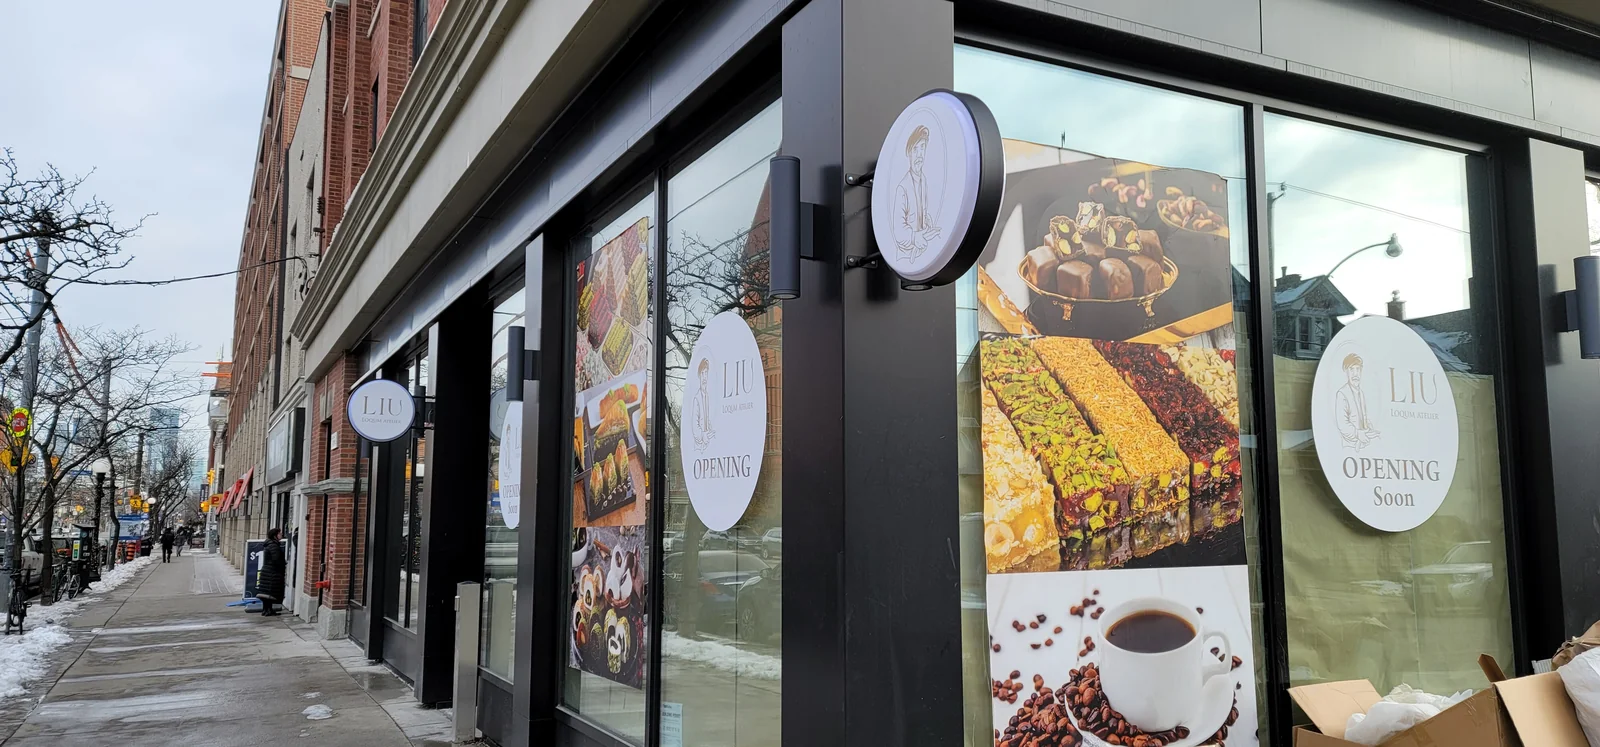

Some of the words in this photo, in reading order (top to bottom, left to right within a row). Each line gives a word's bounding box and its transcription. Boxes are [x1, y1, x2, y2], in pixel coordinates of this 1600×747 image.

[723, 358, 753, 398] LIU
[1389, 367, 1438, 405] LIU
[363, 396, 403, 416] LIU
[1390, 408, 1416, 420] LOQUM
[1417, 411, 1440, 420] ATELIER
[693, 454, 751, 480] OPENING
[1342, 456, 1440, 482] OPENING
[1373, 486, 1415, 507] Soon
